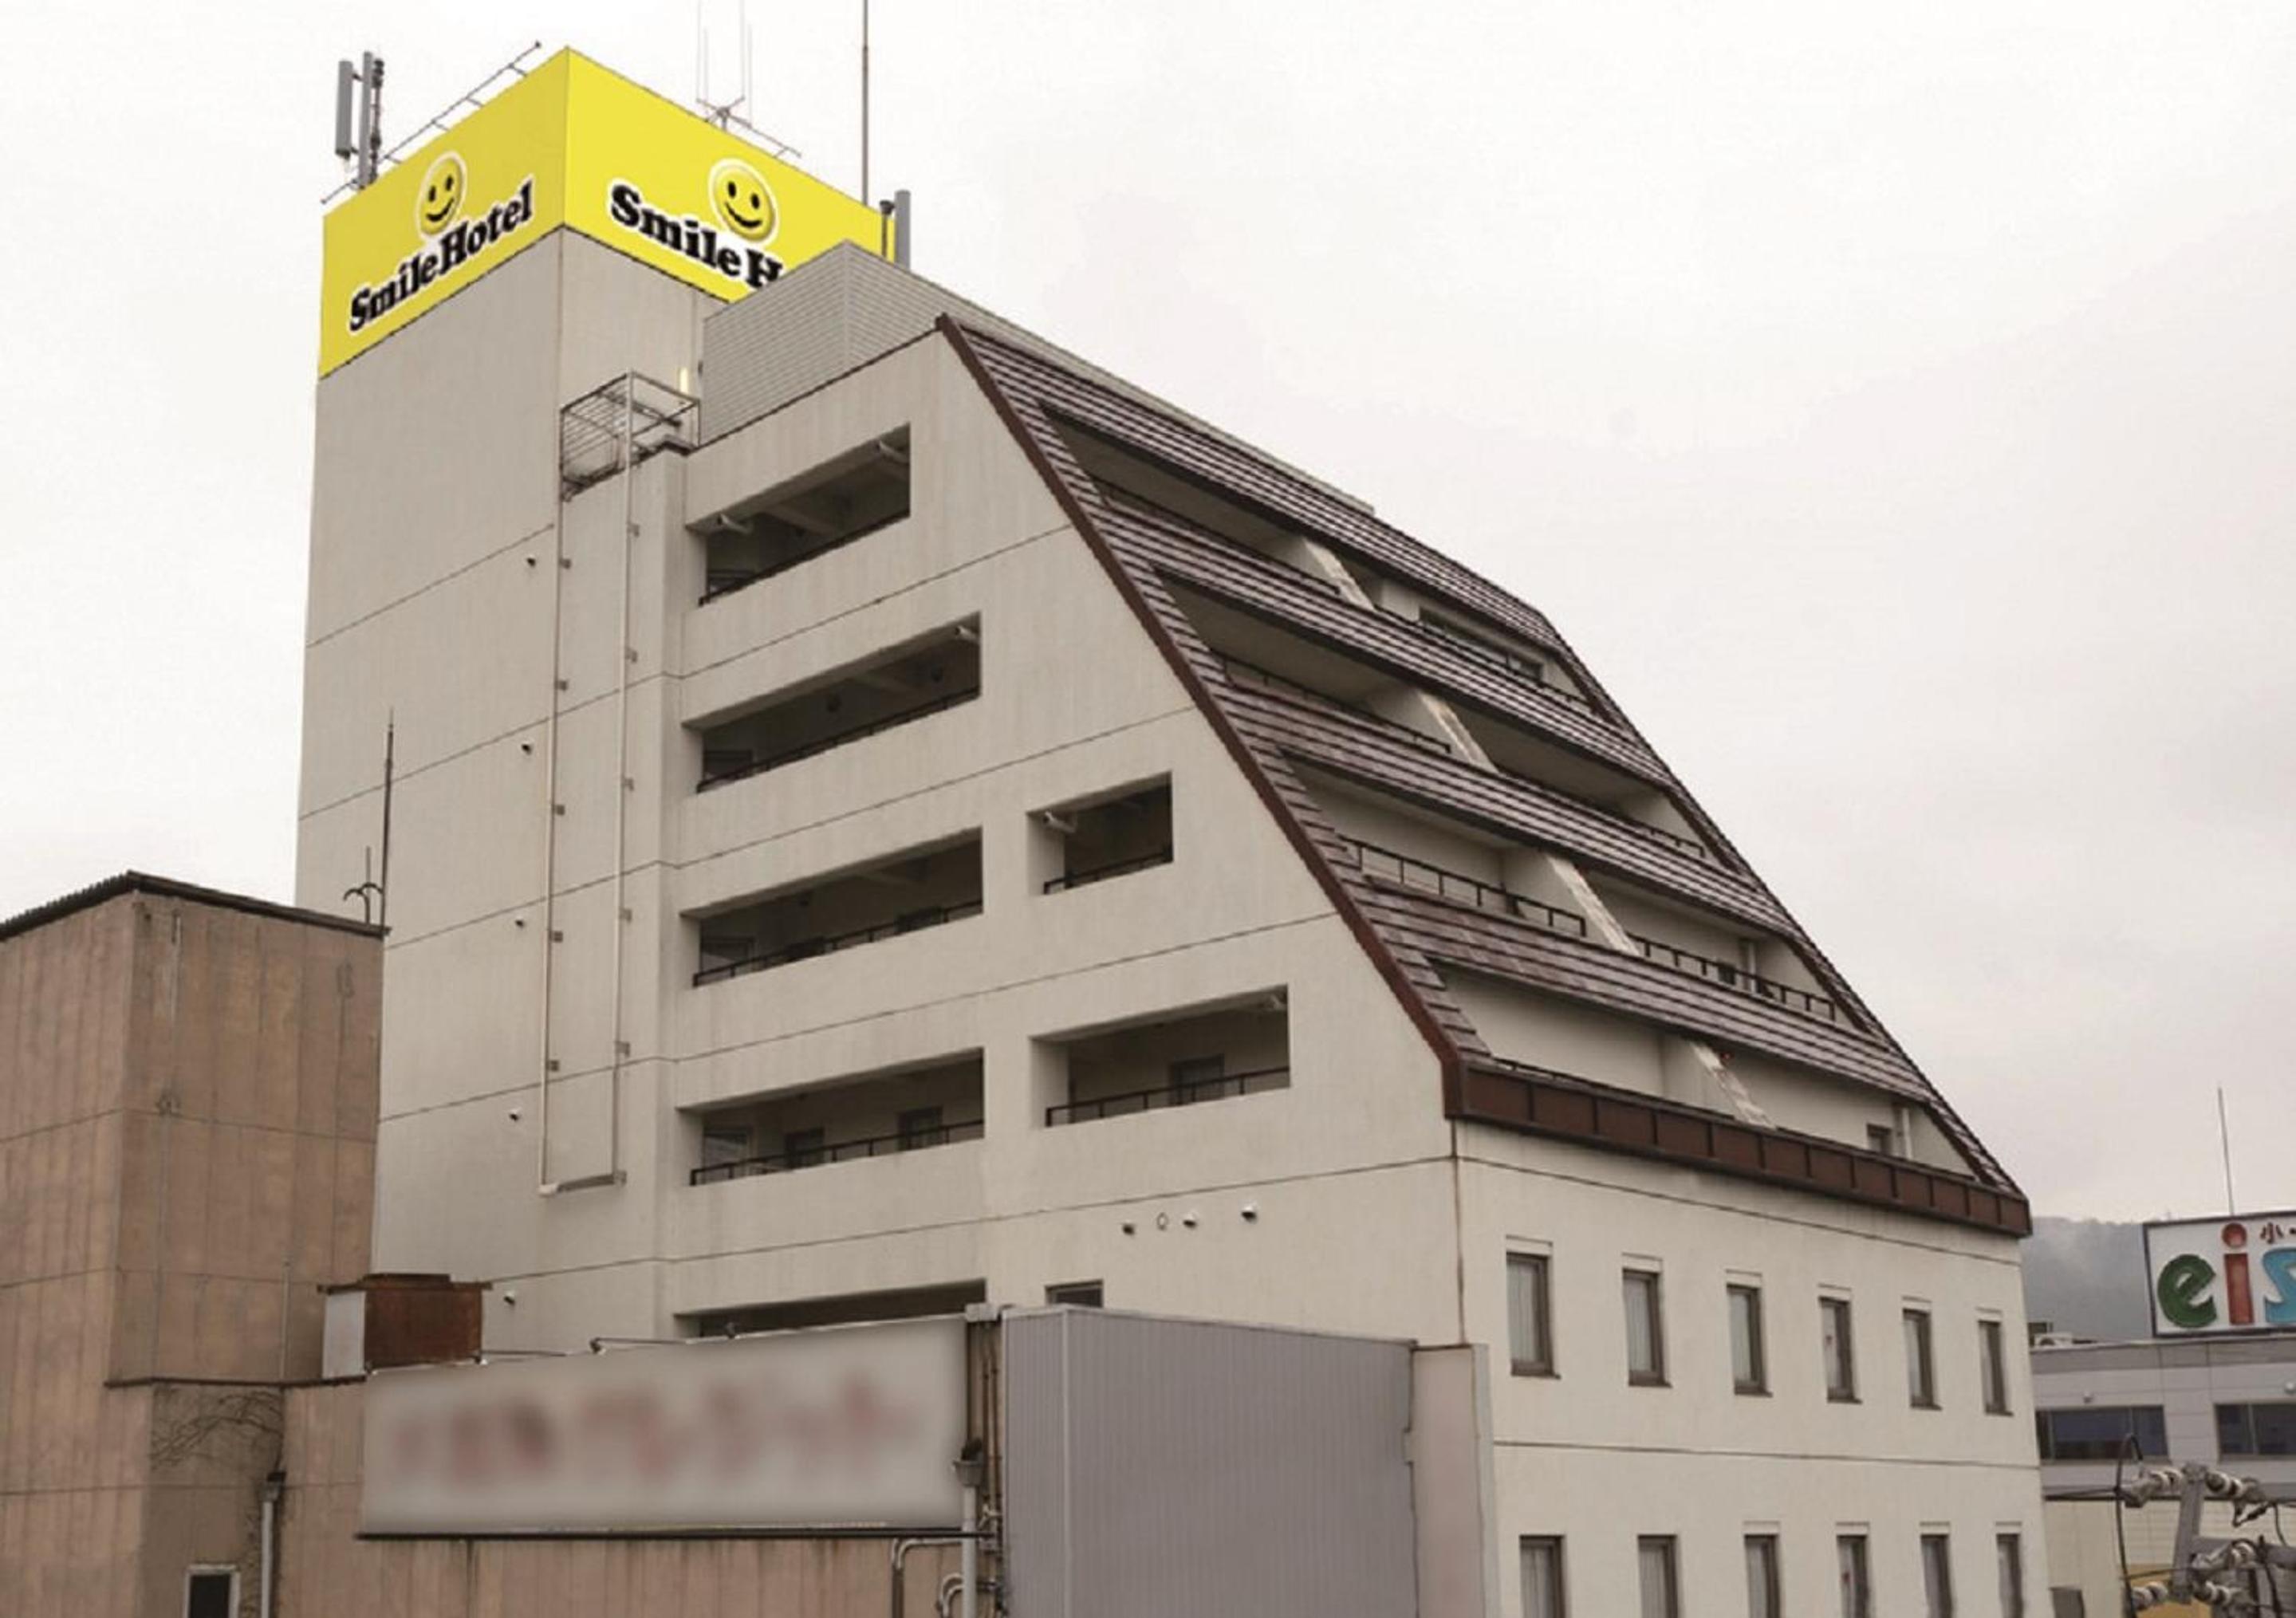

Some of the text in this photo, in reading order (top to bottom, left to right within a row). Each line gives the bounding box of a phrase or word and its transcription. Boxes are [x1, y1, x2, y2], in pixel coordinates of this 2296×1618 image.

[350, 180, 532, 331] Smile Hotel
[611, 183, 742, 277] Smile
